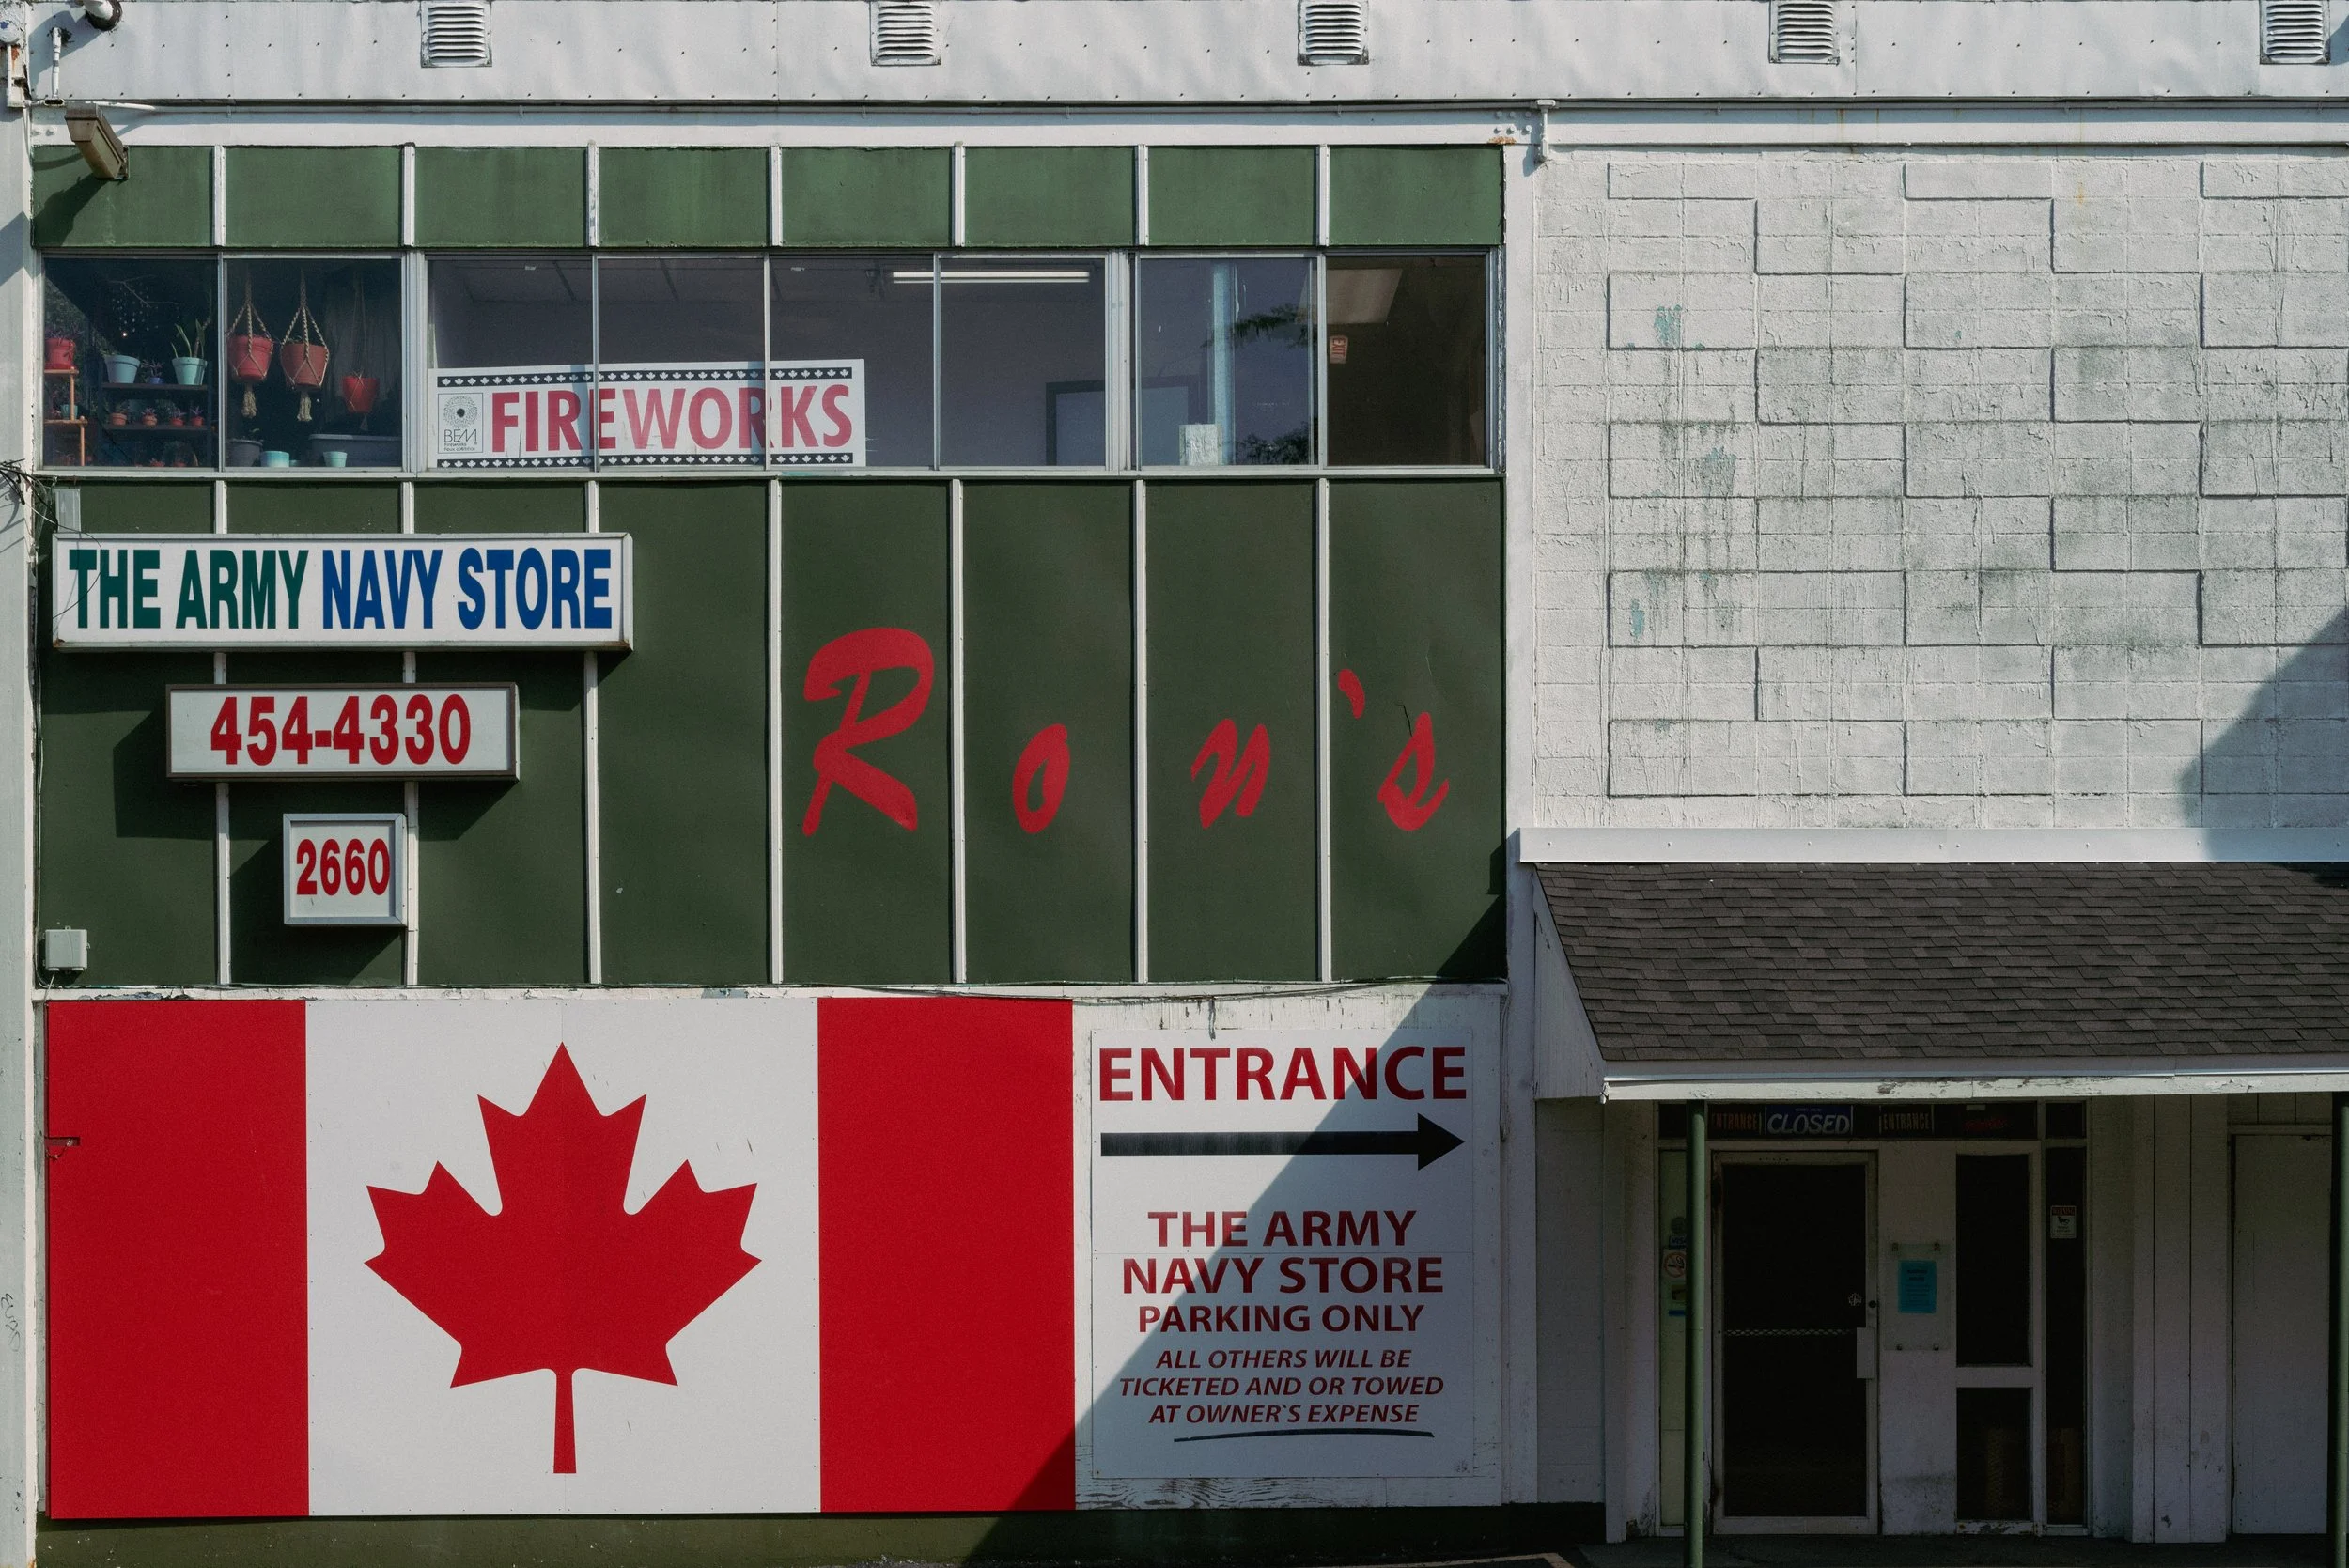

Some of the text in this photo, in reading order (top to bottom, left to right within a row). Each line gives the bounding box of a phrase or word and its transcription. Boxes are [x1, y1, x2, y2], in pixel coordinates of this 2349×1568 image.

[1332, 338, 1346, 357] EXIT
[492, 385, 851, 452] FIREWORKS
[70, 547, 613, 630] THE ARMY NAVY STORE
[210, 694, 471, 766] 454-4330
[802, 627, 1450, 837] Ron's
[296, 838, 390, 896] 2660
[1099, 1046, 1467, 1101] ENTRANCE
[1767, 1113, 1850, 1134] CLOSED
[1883, 1112, 1930, 1130] ENTRANCE
[1147, 1209, 1417, 1247] THE ARMY
[1123, 1256, 1444, 1295] NAVY STORE
[1139, 1304, 1424, 1334] PARKING ONLY
[1156, 1349, 1412, 1369] ALL OTHERS WILL BE
[1119, 1376, 1444, 1396] TICKETED AND OR TOWED
[1149, 1405, 1181, 1423] AT
[1307, 1404, 1420, 1422] EXPENSE
